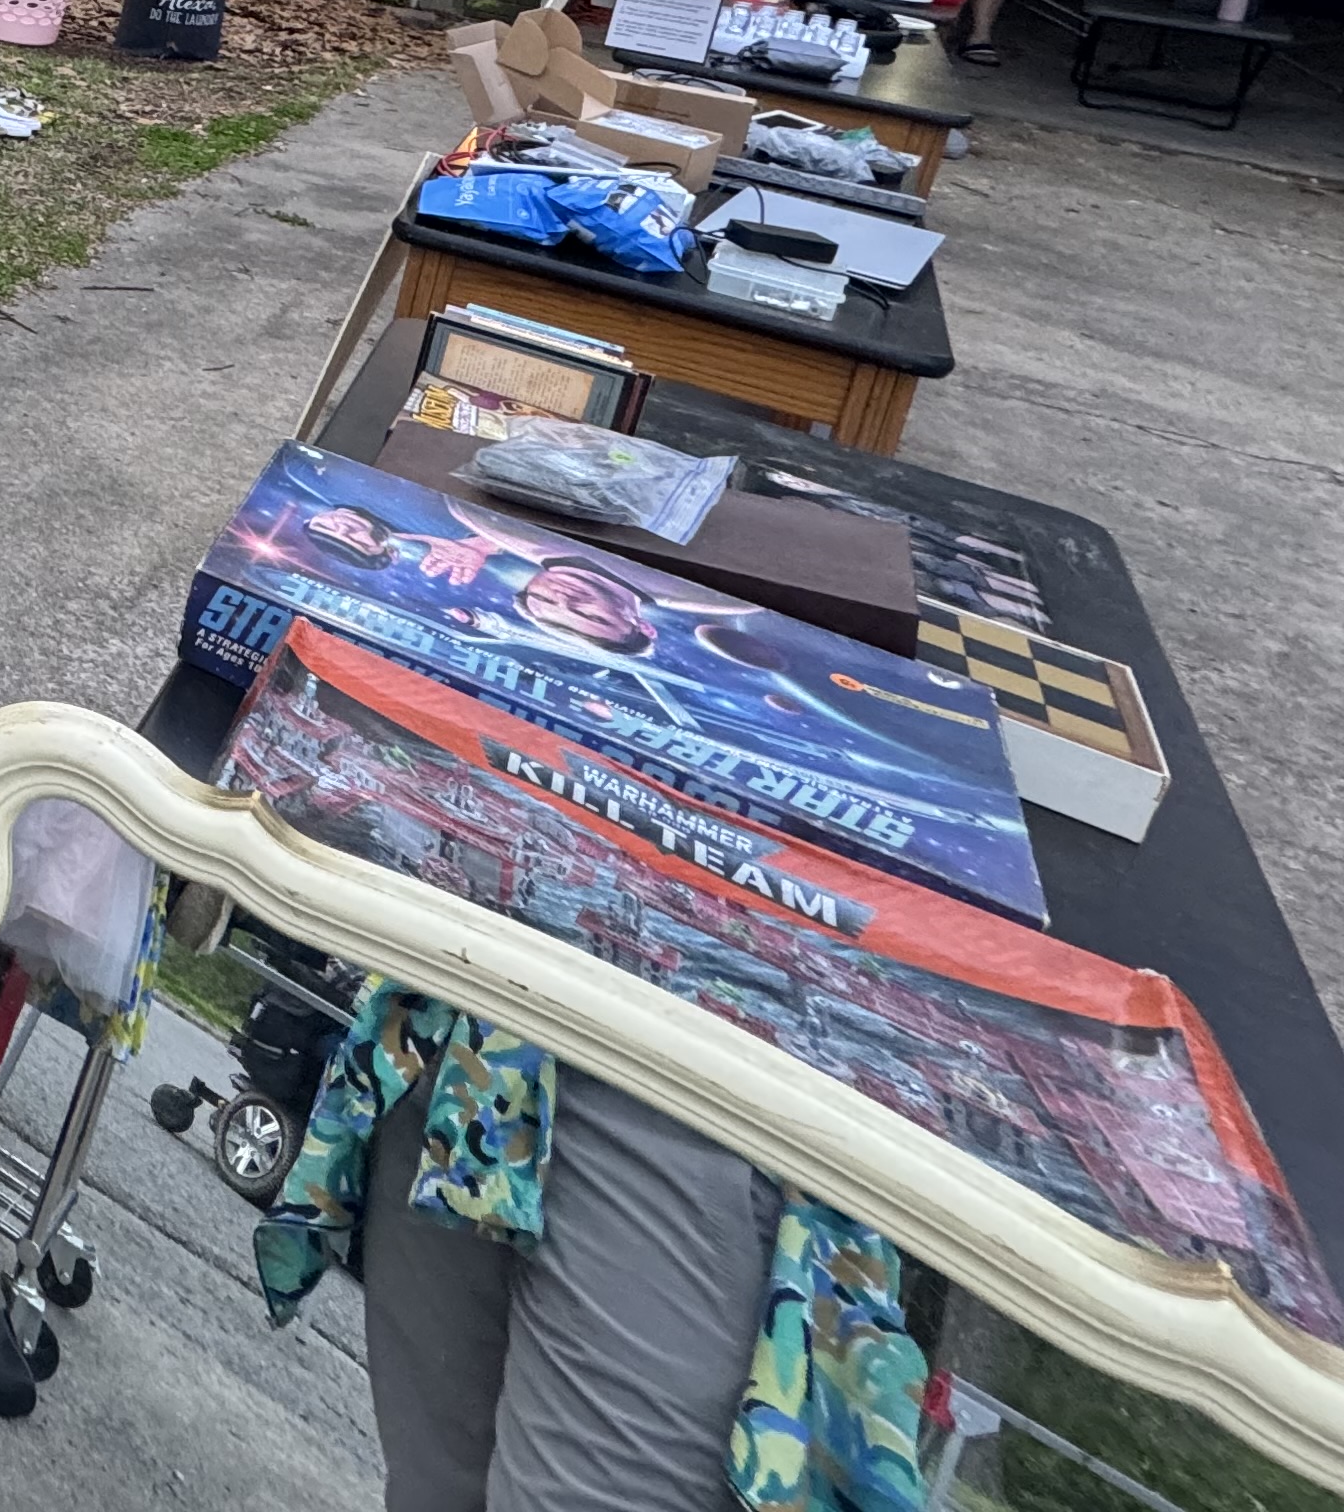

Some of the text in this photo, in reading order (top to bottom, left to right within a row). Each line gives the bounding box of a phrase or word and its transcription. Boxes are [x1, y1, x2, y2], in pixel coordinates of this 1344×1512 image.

[149, 7, 163, 21] DO
[166, 10, 183, 24] THE
[194, 637, 215, 652] For
[216, 647, 245, 666] Ages
[198, 584, 293, 654] STA
[445, 643, 560, 707] THE
[505, 750, 635, 830] KILL
[650, 816, 839, 928] TEAM
[583, 764, 753, 855] WARHAMMER
[745, 760, 918, 855] STAR
